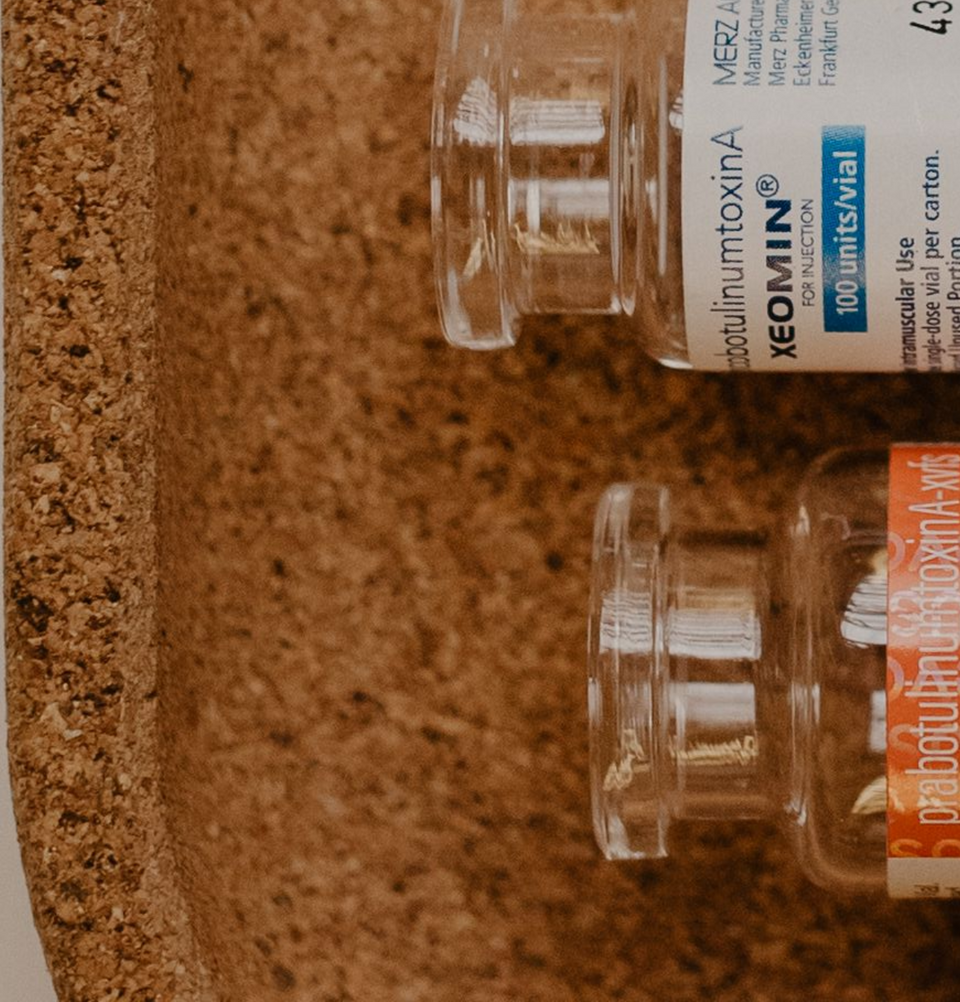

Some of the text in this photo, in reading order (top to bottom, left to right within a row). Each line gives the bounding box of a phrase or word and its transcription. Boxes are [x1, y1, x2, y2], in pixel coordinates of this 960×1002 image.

[712, 19, 739, 86] MERZ
[768, 48, 788, 86] Merz
[793, 0, 815, 86] Eckenheimer
[818, 20, 839, 86] Frankfurt
[922, 149, 940, 221] carton.
[800, 199, 816, 307] FOR INJECTION
[832, 151, 859, 315] 100 units/vial
[896, 237, 916, 272] Use
[924, 228, 944, 259] per
[920, 266, 940, 296] vial
